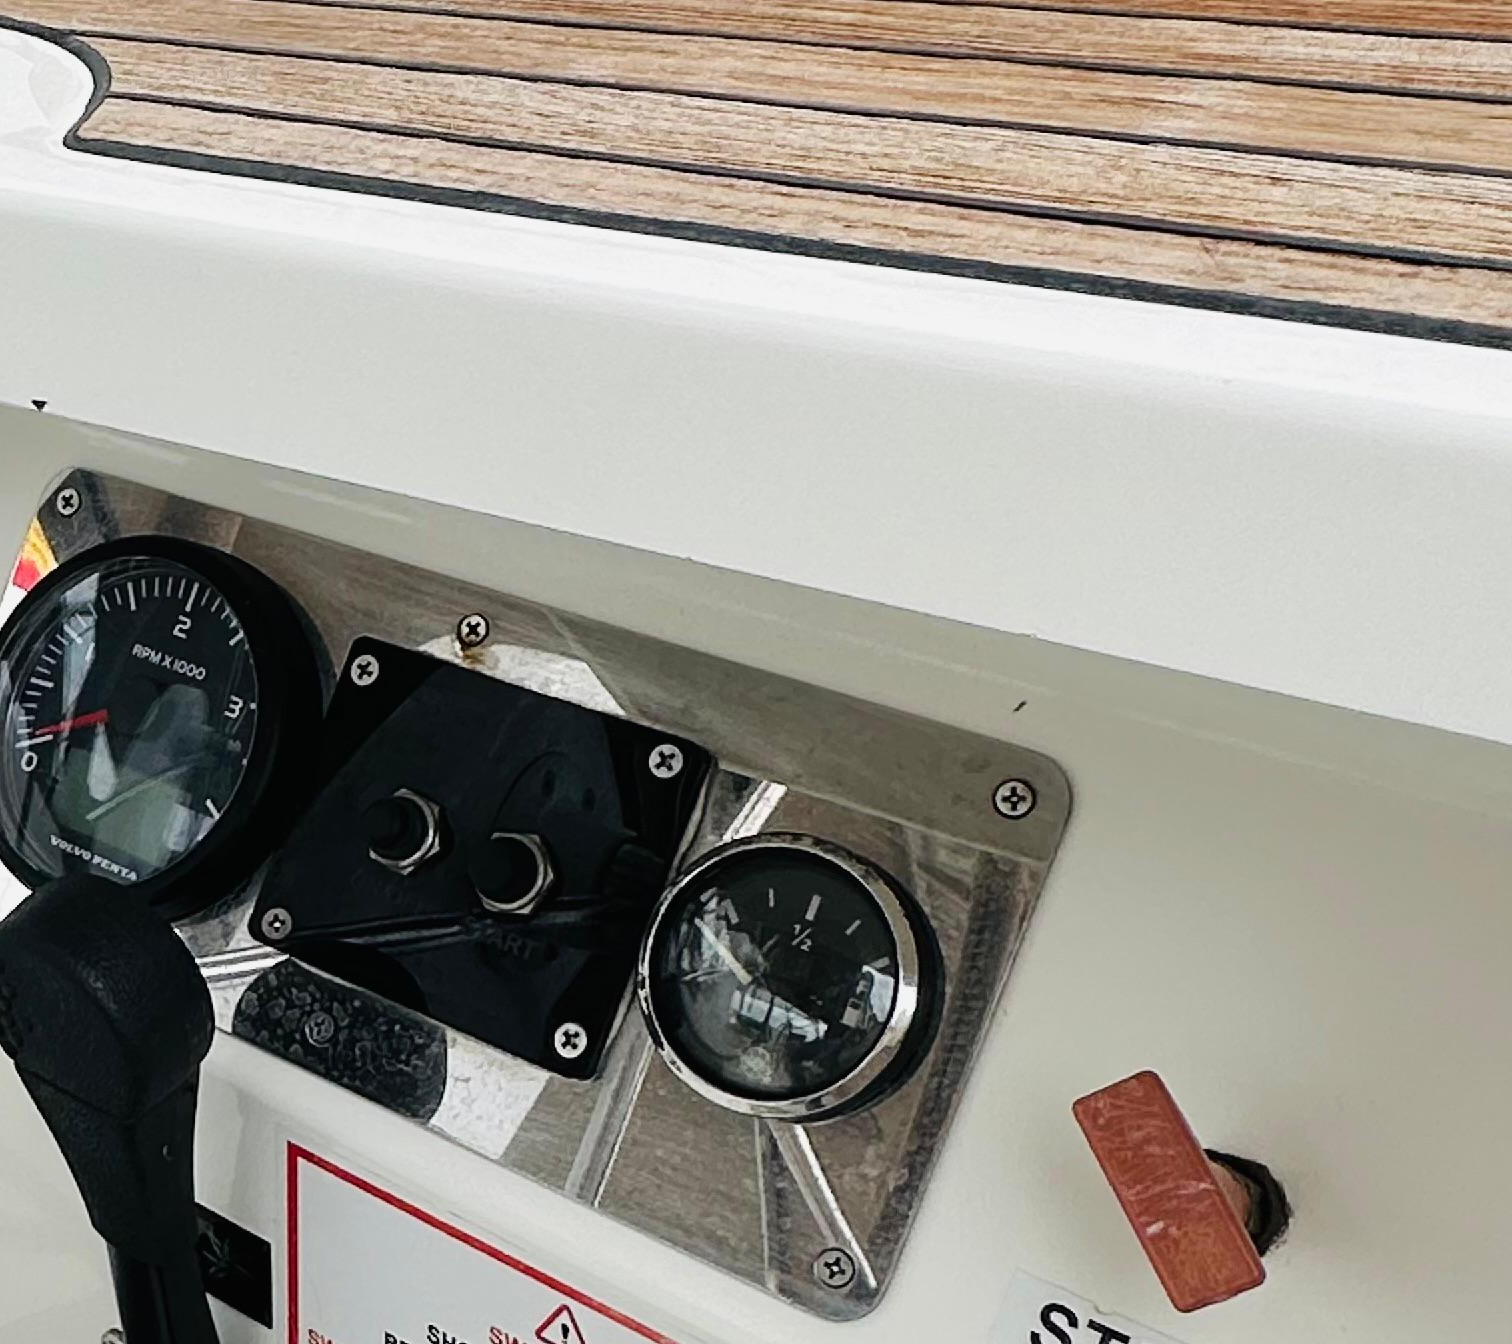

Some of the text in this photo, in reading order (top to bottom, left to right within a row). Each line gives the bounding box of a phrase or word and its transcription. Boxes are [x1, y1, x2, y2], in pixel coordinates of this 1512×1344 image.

[173, 616, 192, 639] 2
[132, 643, 162, 665] RPM
[224, 696, 244, 719] 3
[21, 751, 37, 772] 0
[49, 834, 138, 881] VOLVO PENTA
